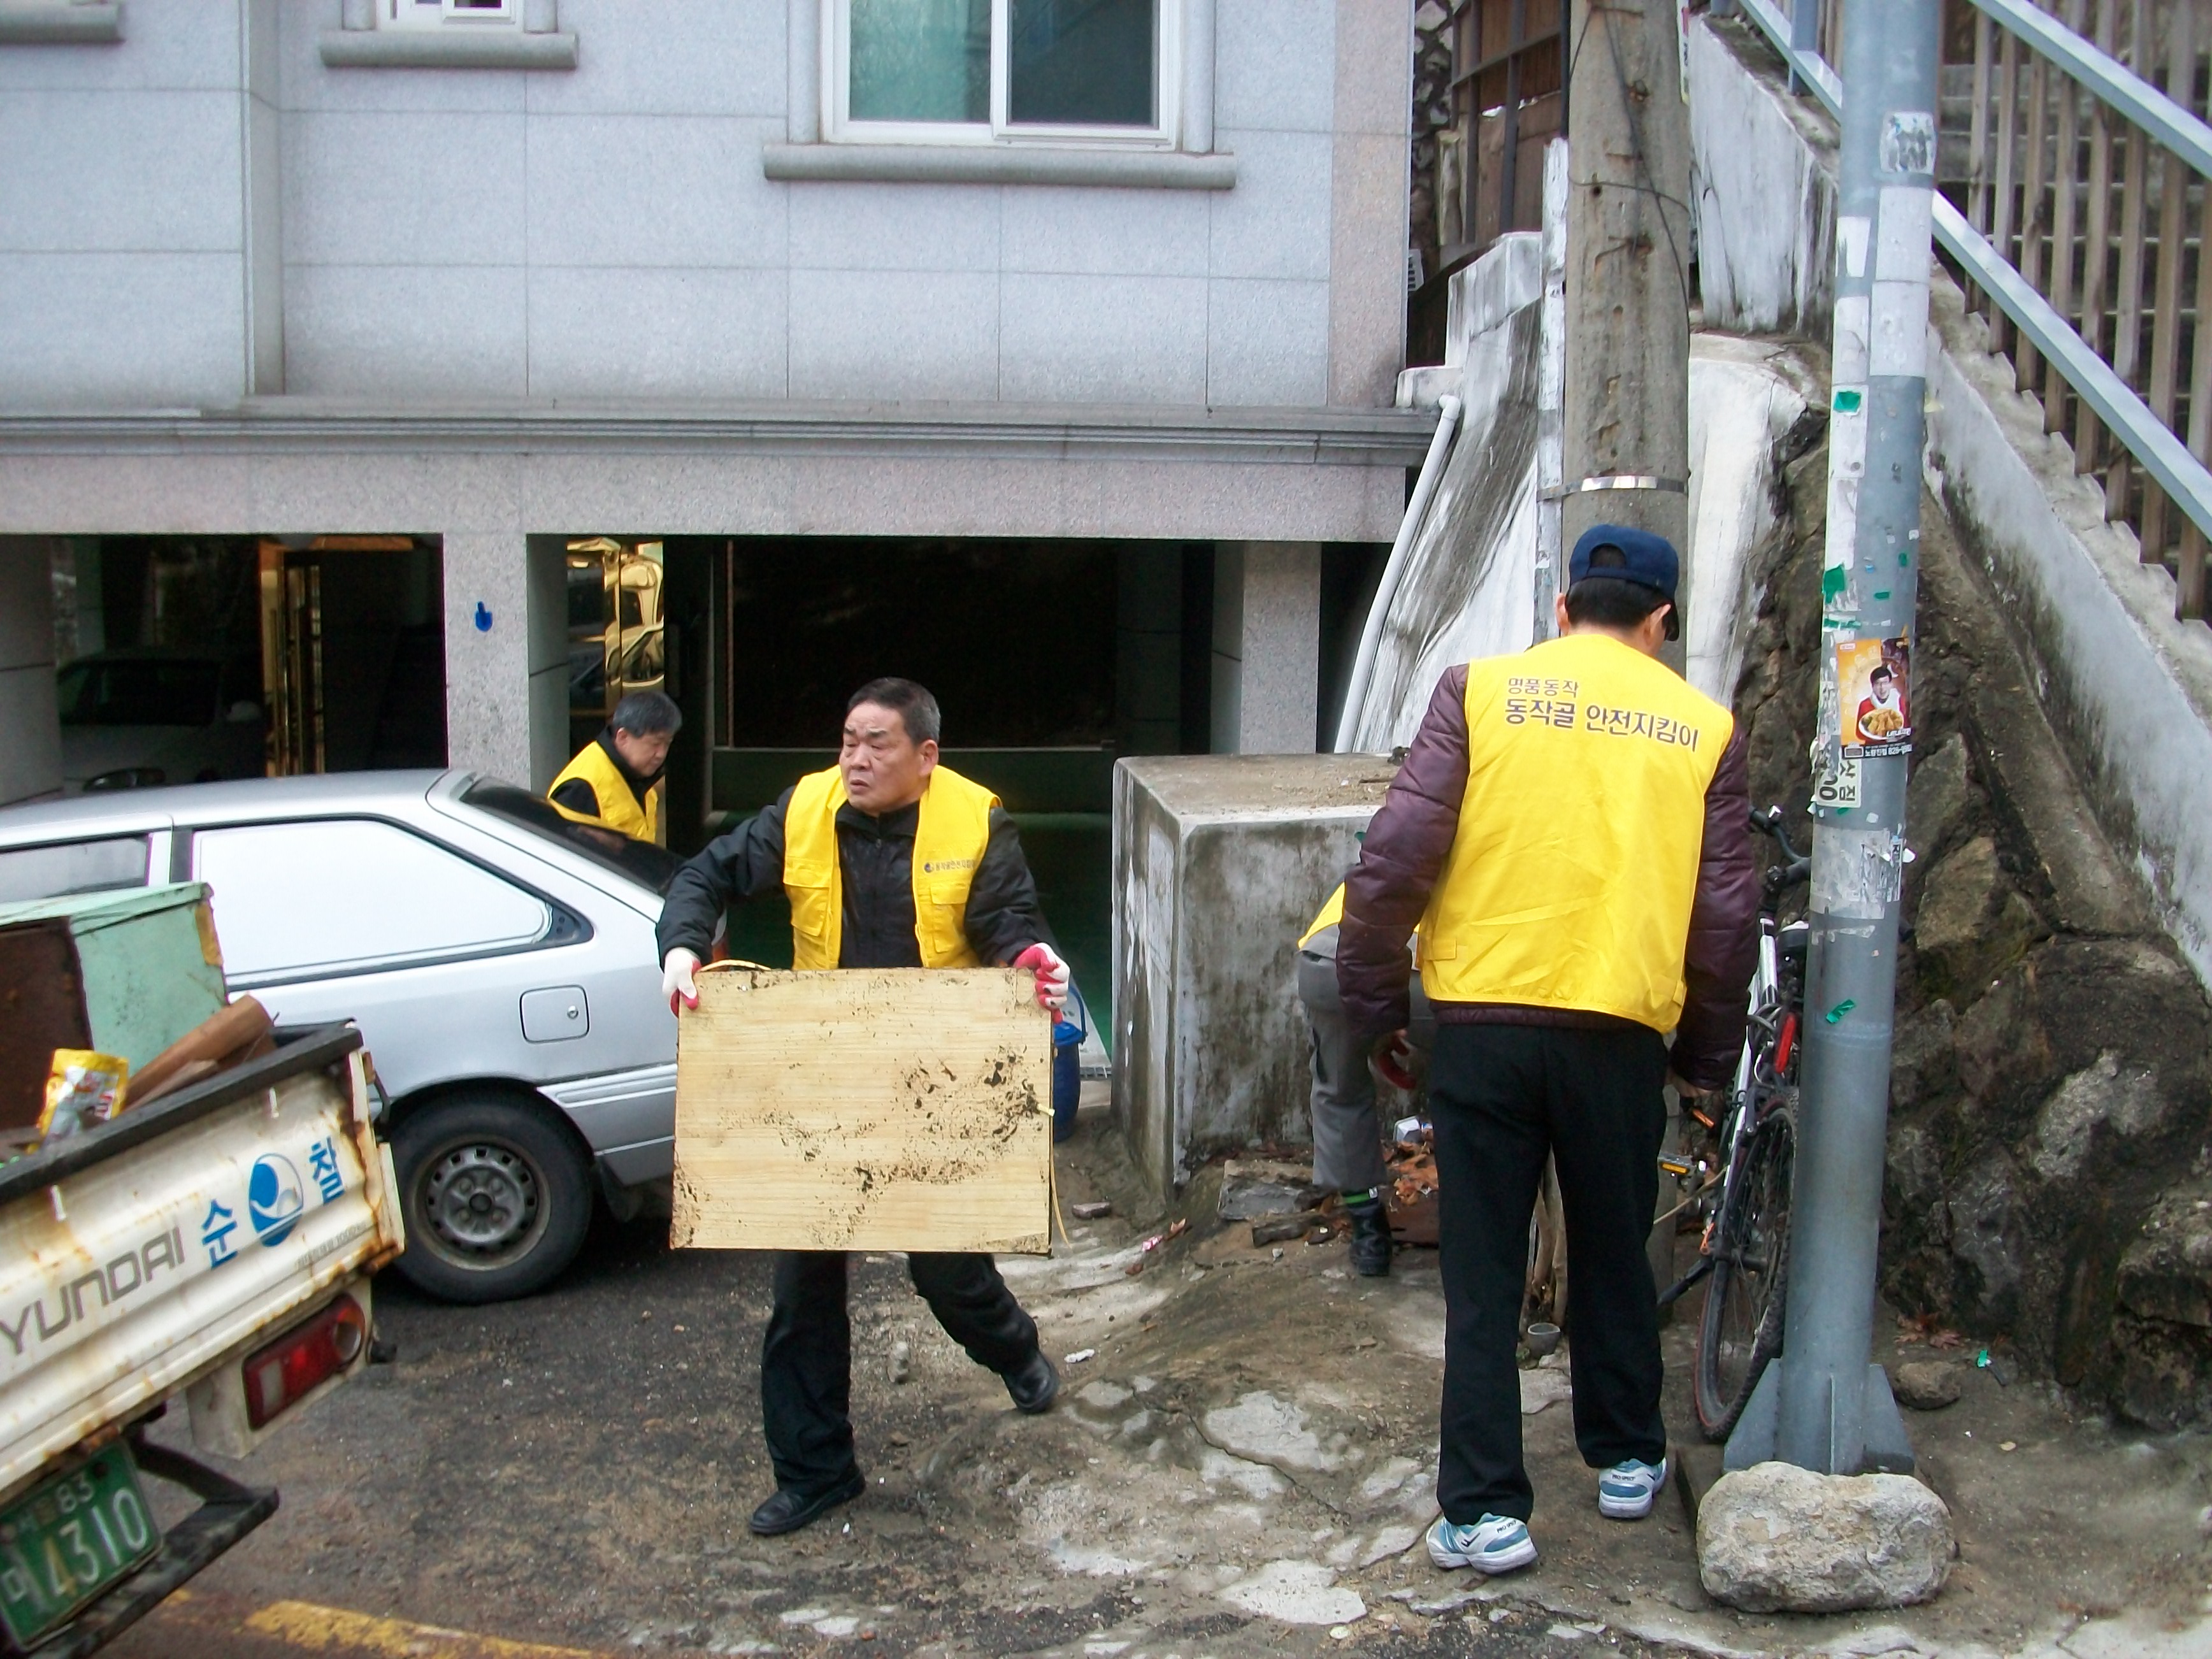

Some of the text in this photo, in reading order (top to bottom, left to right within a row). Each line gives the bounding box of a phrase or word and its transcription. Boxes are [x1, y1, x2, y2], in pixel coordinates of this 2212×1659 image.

[1505, 698, 1699, 752] 동작골 안전지킴이
[201, 1198, 238, 1270] 순
[57, 1473, 95, 1514] 83
[43, 1487, 148, 1597] 4310
